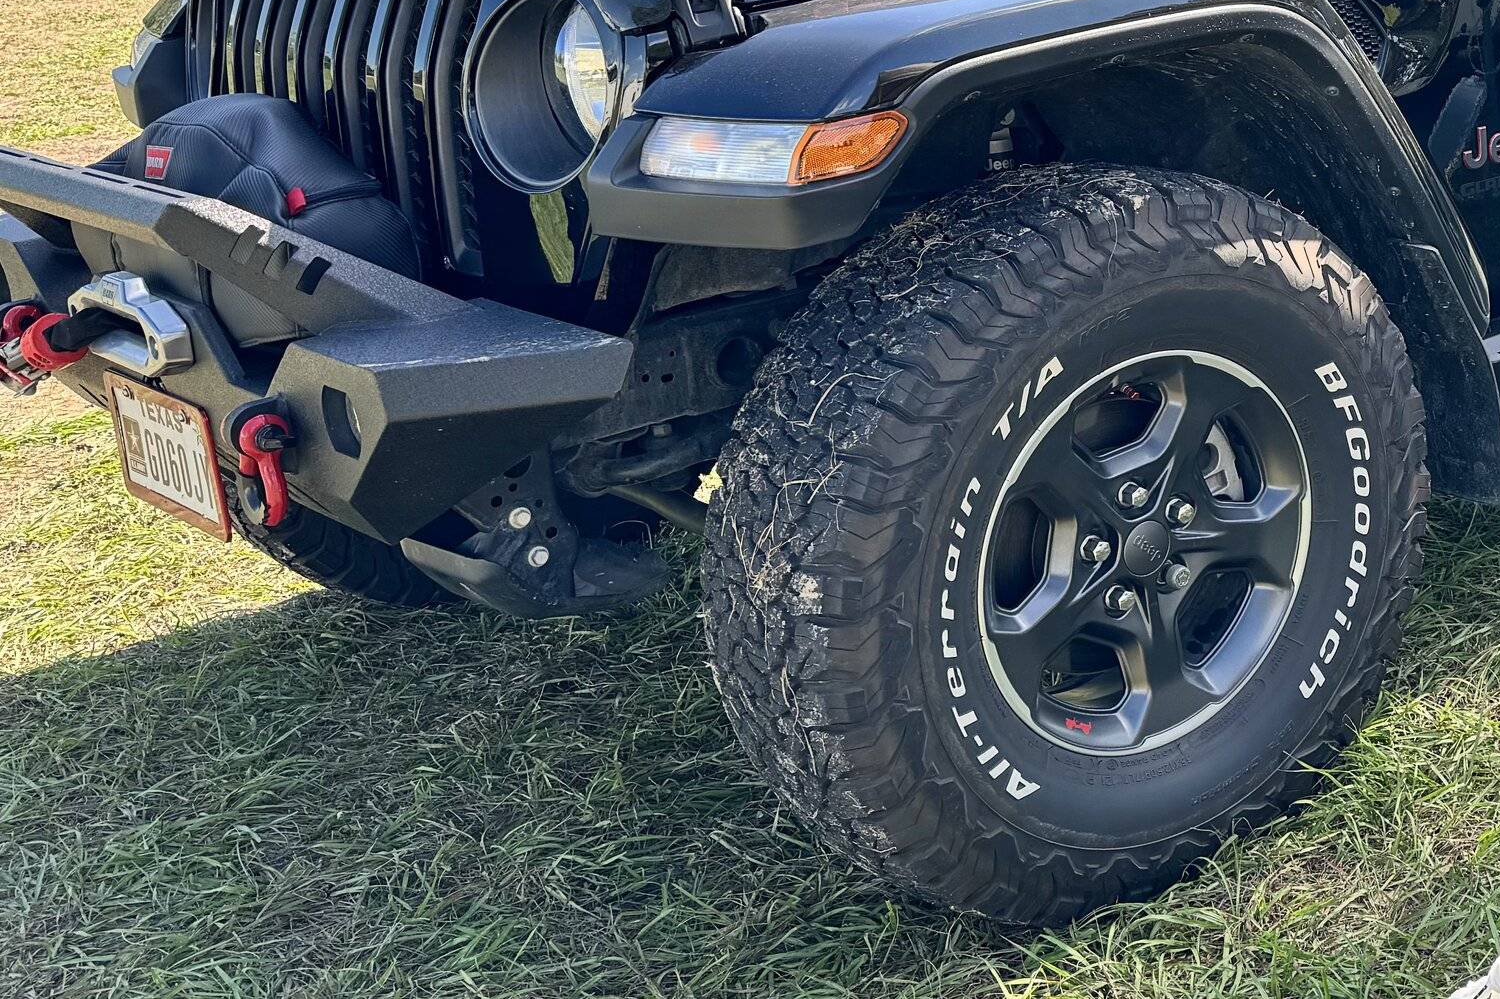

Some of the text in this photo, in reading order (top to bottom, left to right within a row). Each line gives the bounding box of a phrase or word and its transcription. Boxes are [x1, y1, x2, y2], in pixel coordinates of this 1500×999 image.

[138, 399, 184, 434] TEXAS
[992, 356, 1065, 441] T/A
[1299, 362, 1372, 700] BFGoodrich
[940, 477, 1041, 800] All-Terrain
